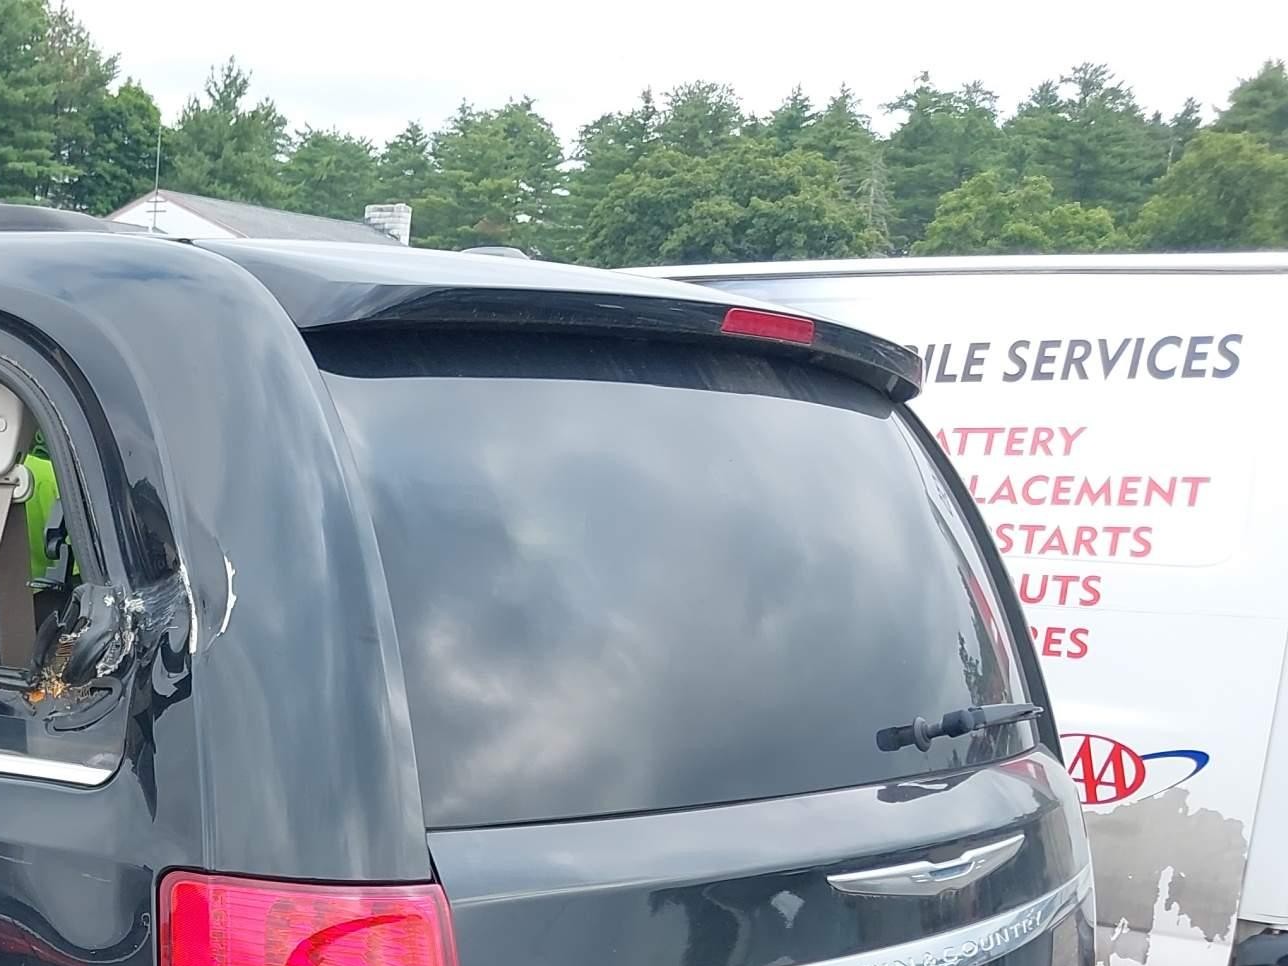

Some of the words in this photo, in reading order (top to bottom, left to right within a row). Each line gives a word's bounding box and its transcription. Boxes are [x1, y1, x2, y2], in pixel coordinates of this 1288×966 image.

[904, 342, 991, 383] ILE
[1002, 334, 1243, 383] SERVICES
[995, 523, 1153, 558] STARTS
[1030, 626, 1089, 659] ES
